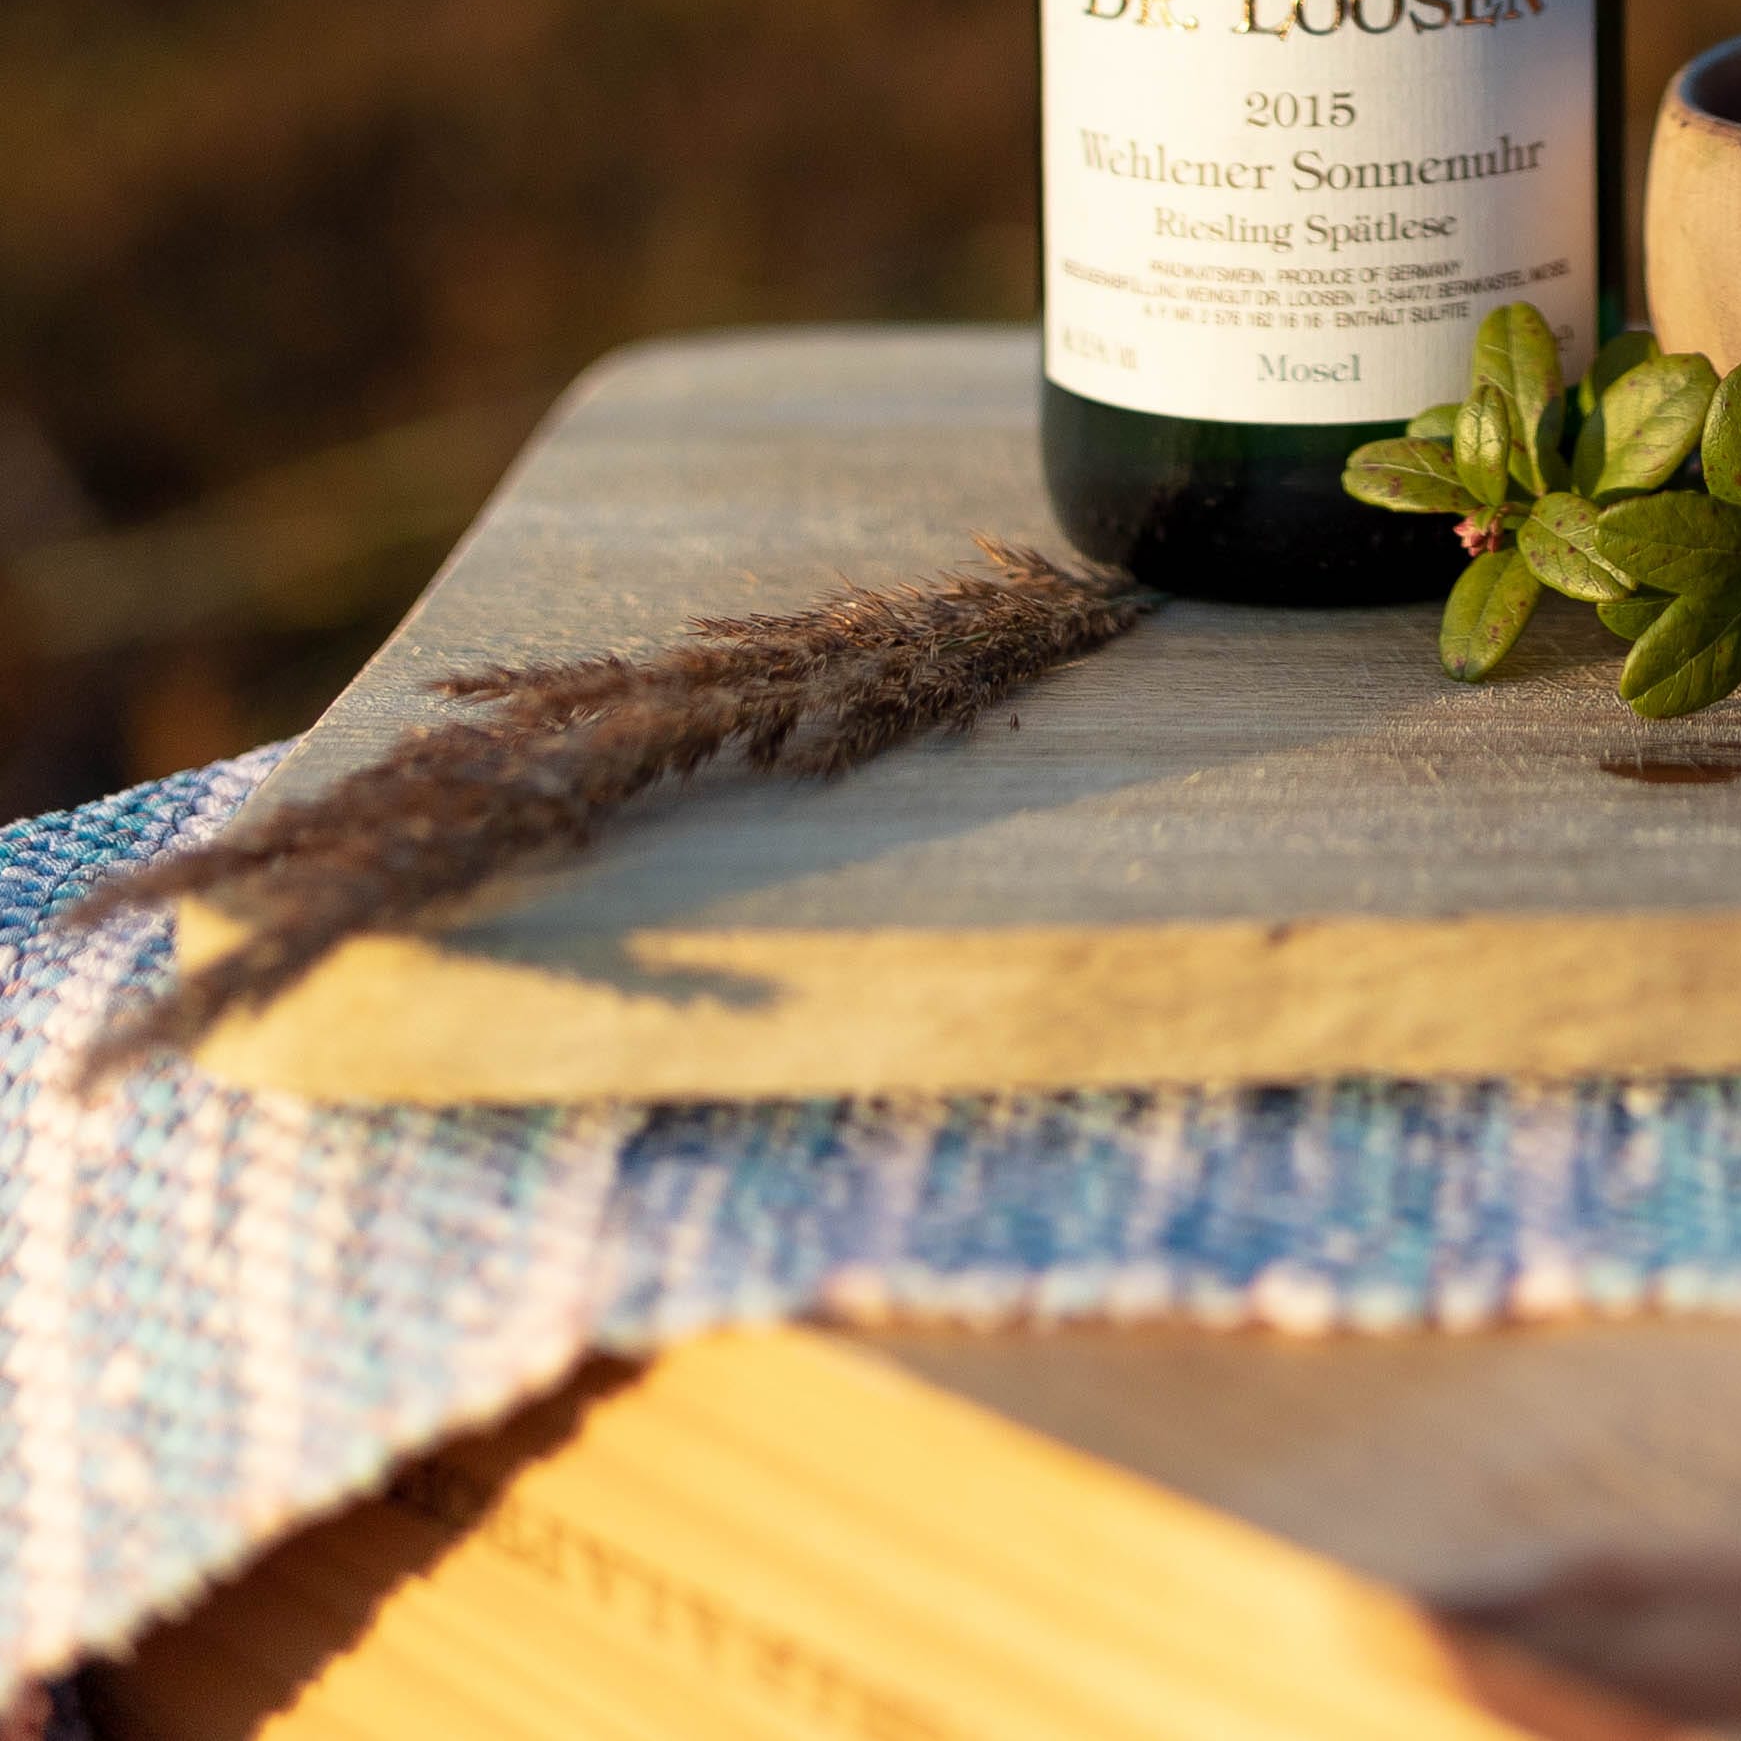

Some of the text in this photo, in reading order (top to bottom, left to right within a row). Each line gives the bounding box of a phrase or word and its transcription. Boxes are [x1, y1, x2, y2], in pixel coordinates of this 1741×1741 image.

[1244, 90, 1358, 129] 2015
[1079, 127, 1546, 191] Wehlener Sonnenuhr
[1153, 206, 1459, 253] Riesling Spätlese
[1278, 268, 1354, 286] PRODUCE
[1358, 266, 1381, 284] OF
[1287, 289, 1356, 307] LOOSEN
[1255, 353, 1362, 384] Mosel
